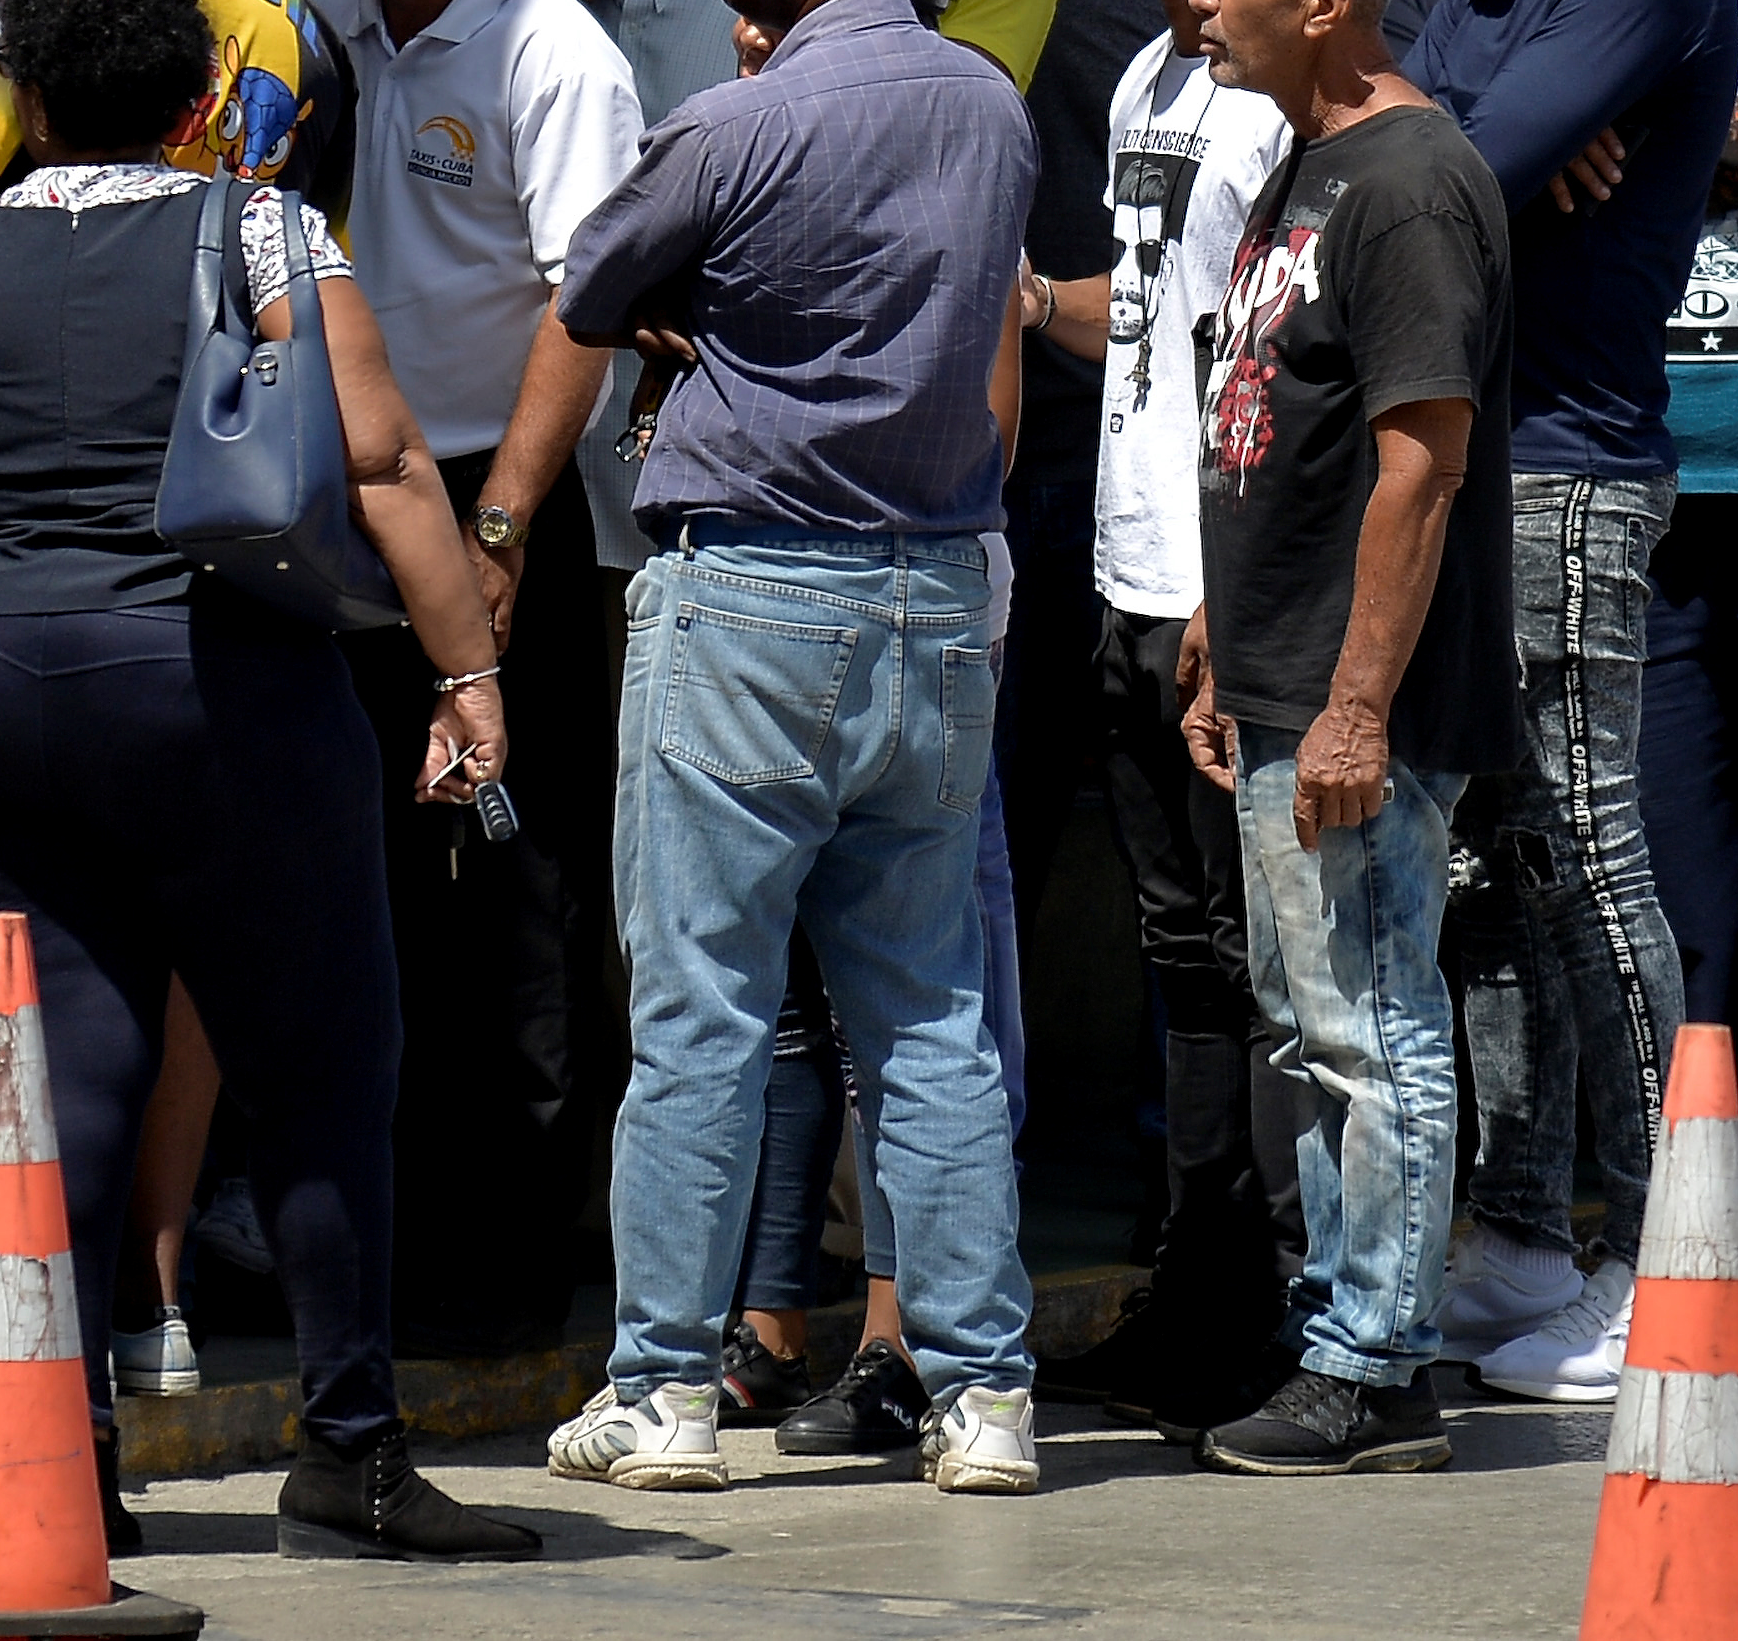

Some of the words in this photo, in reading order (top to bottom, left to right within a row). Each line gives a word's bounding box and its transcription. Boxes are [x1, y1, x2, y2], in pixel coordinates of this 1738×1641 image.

[1565, 555, 1584, 655] OFF-WHITE
[1571, 744, 1591, 837] OFF-WHITE
[1595, 891, 1632, 975] OFF-WHITE
[1642, 1067, 1661, 1163] OFF-WHI
